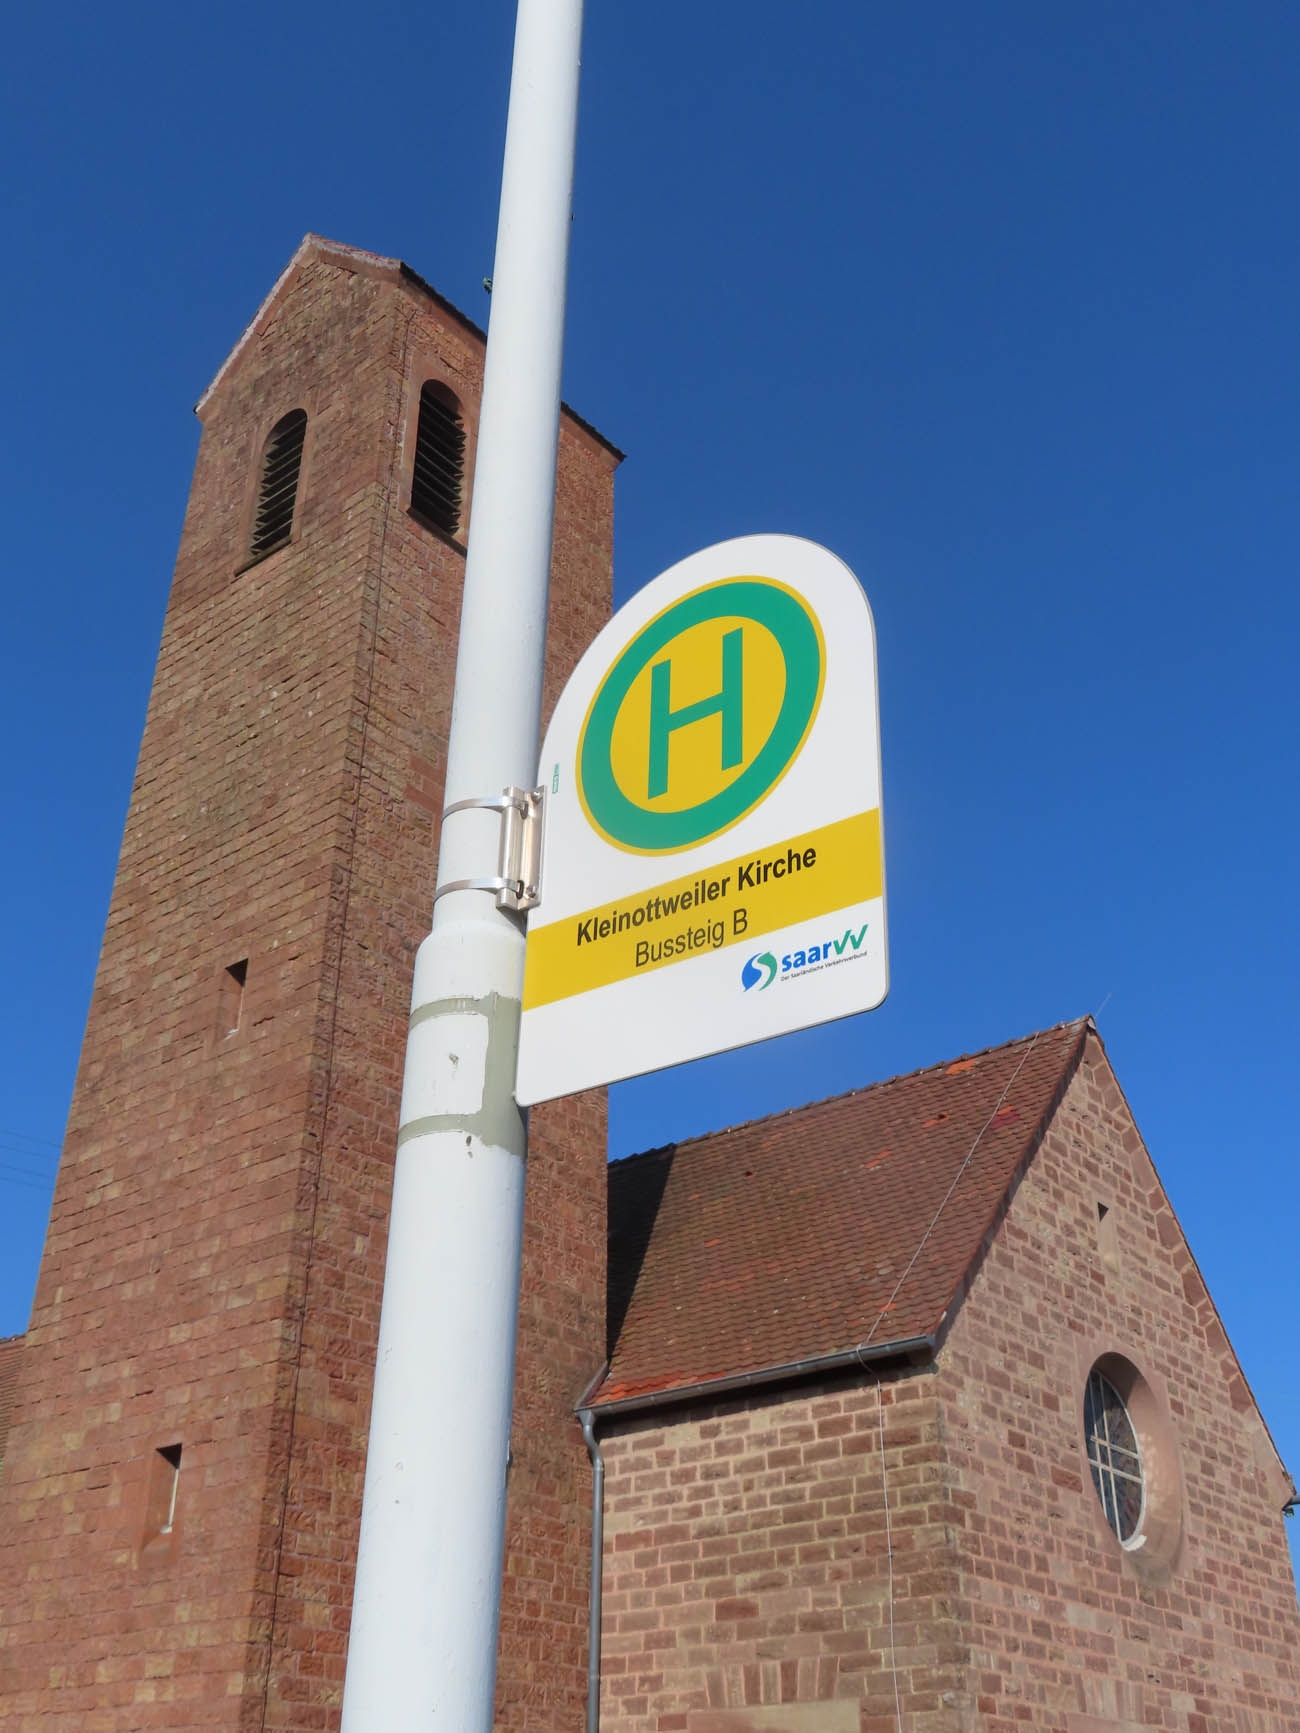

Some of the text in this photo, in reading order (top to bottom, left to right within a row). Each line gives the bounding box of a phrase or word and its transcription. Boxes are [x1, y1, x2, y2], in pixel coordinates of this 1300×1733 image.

[648, 627, 743, 800] H
[576, 848, 816, 946] Kleinottweiler Kirche
[635, 908, 748, 967] Bussteig B
